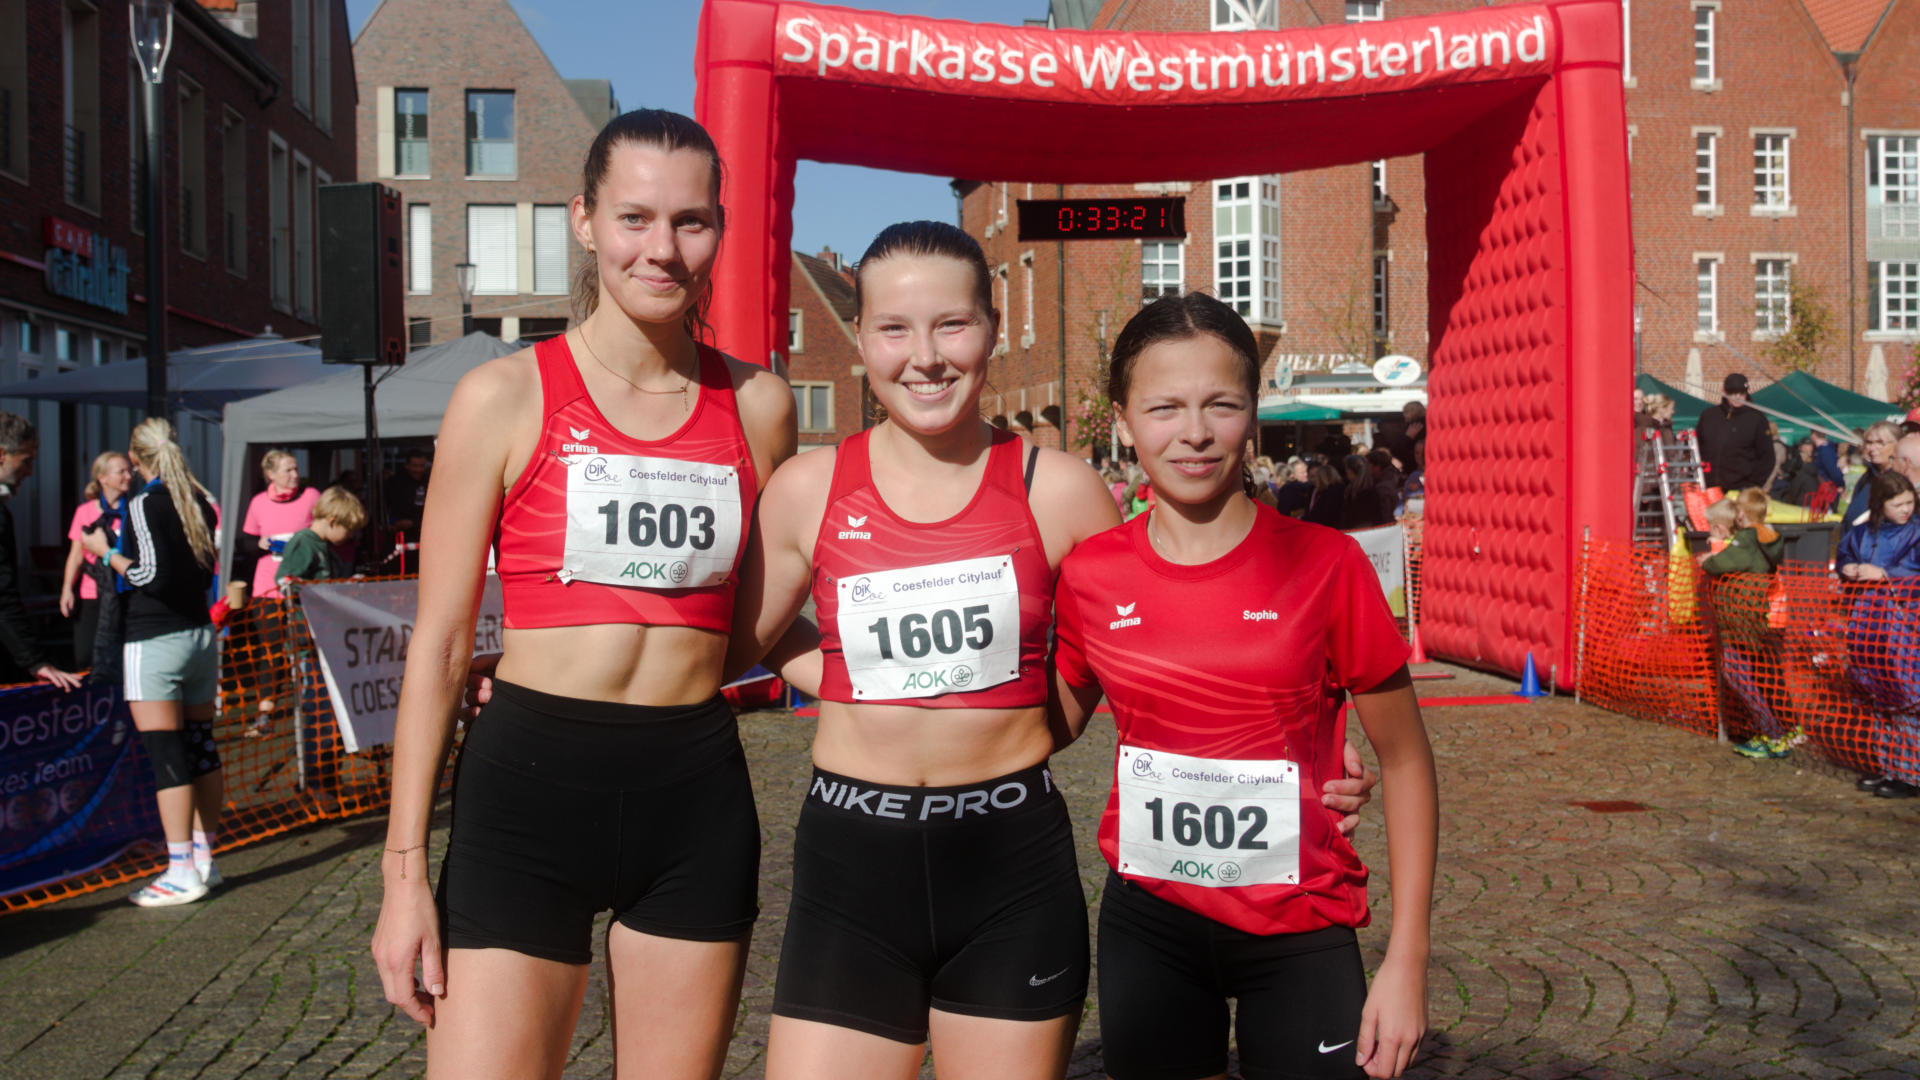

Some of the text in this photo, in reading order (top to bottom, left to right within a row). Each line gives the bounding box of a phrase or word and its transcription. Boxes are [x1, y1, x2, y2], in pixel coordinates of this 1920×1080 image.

[782, 15, 1546, 92] Sparkasse Westmünsterland
[1058, 206, 1165, 232] 0:33:21
[562, 442, 598, 454] erima
[629, 468, 728, 488] Coesfelder Citylauf
[598, 500, 716, 551] 1603
[838, 530, 872, 540] erima
[620, 561, 667, 581] AOK
[893, 568, 1003, 593] Coesfelder Citylauf
[1109, 616, 1141, 630] erima
[1242, 609, 1278, 622] Sophie
[868, 604, 993, 660] 1605
[902, 669, 949, 691] AOK
[34, 753, 94, 785] Team
[1171, 767, 1234, 784] Coesfelder
[1237, 773, 1284, 786] Citylauf
[810, 776, 1027, 821] NIKE PRO
[1145, 797, 1268, 850] 1602
[1170, 859, 1214, 880] AOK
